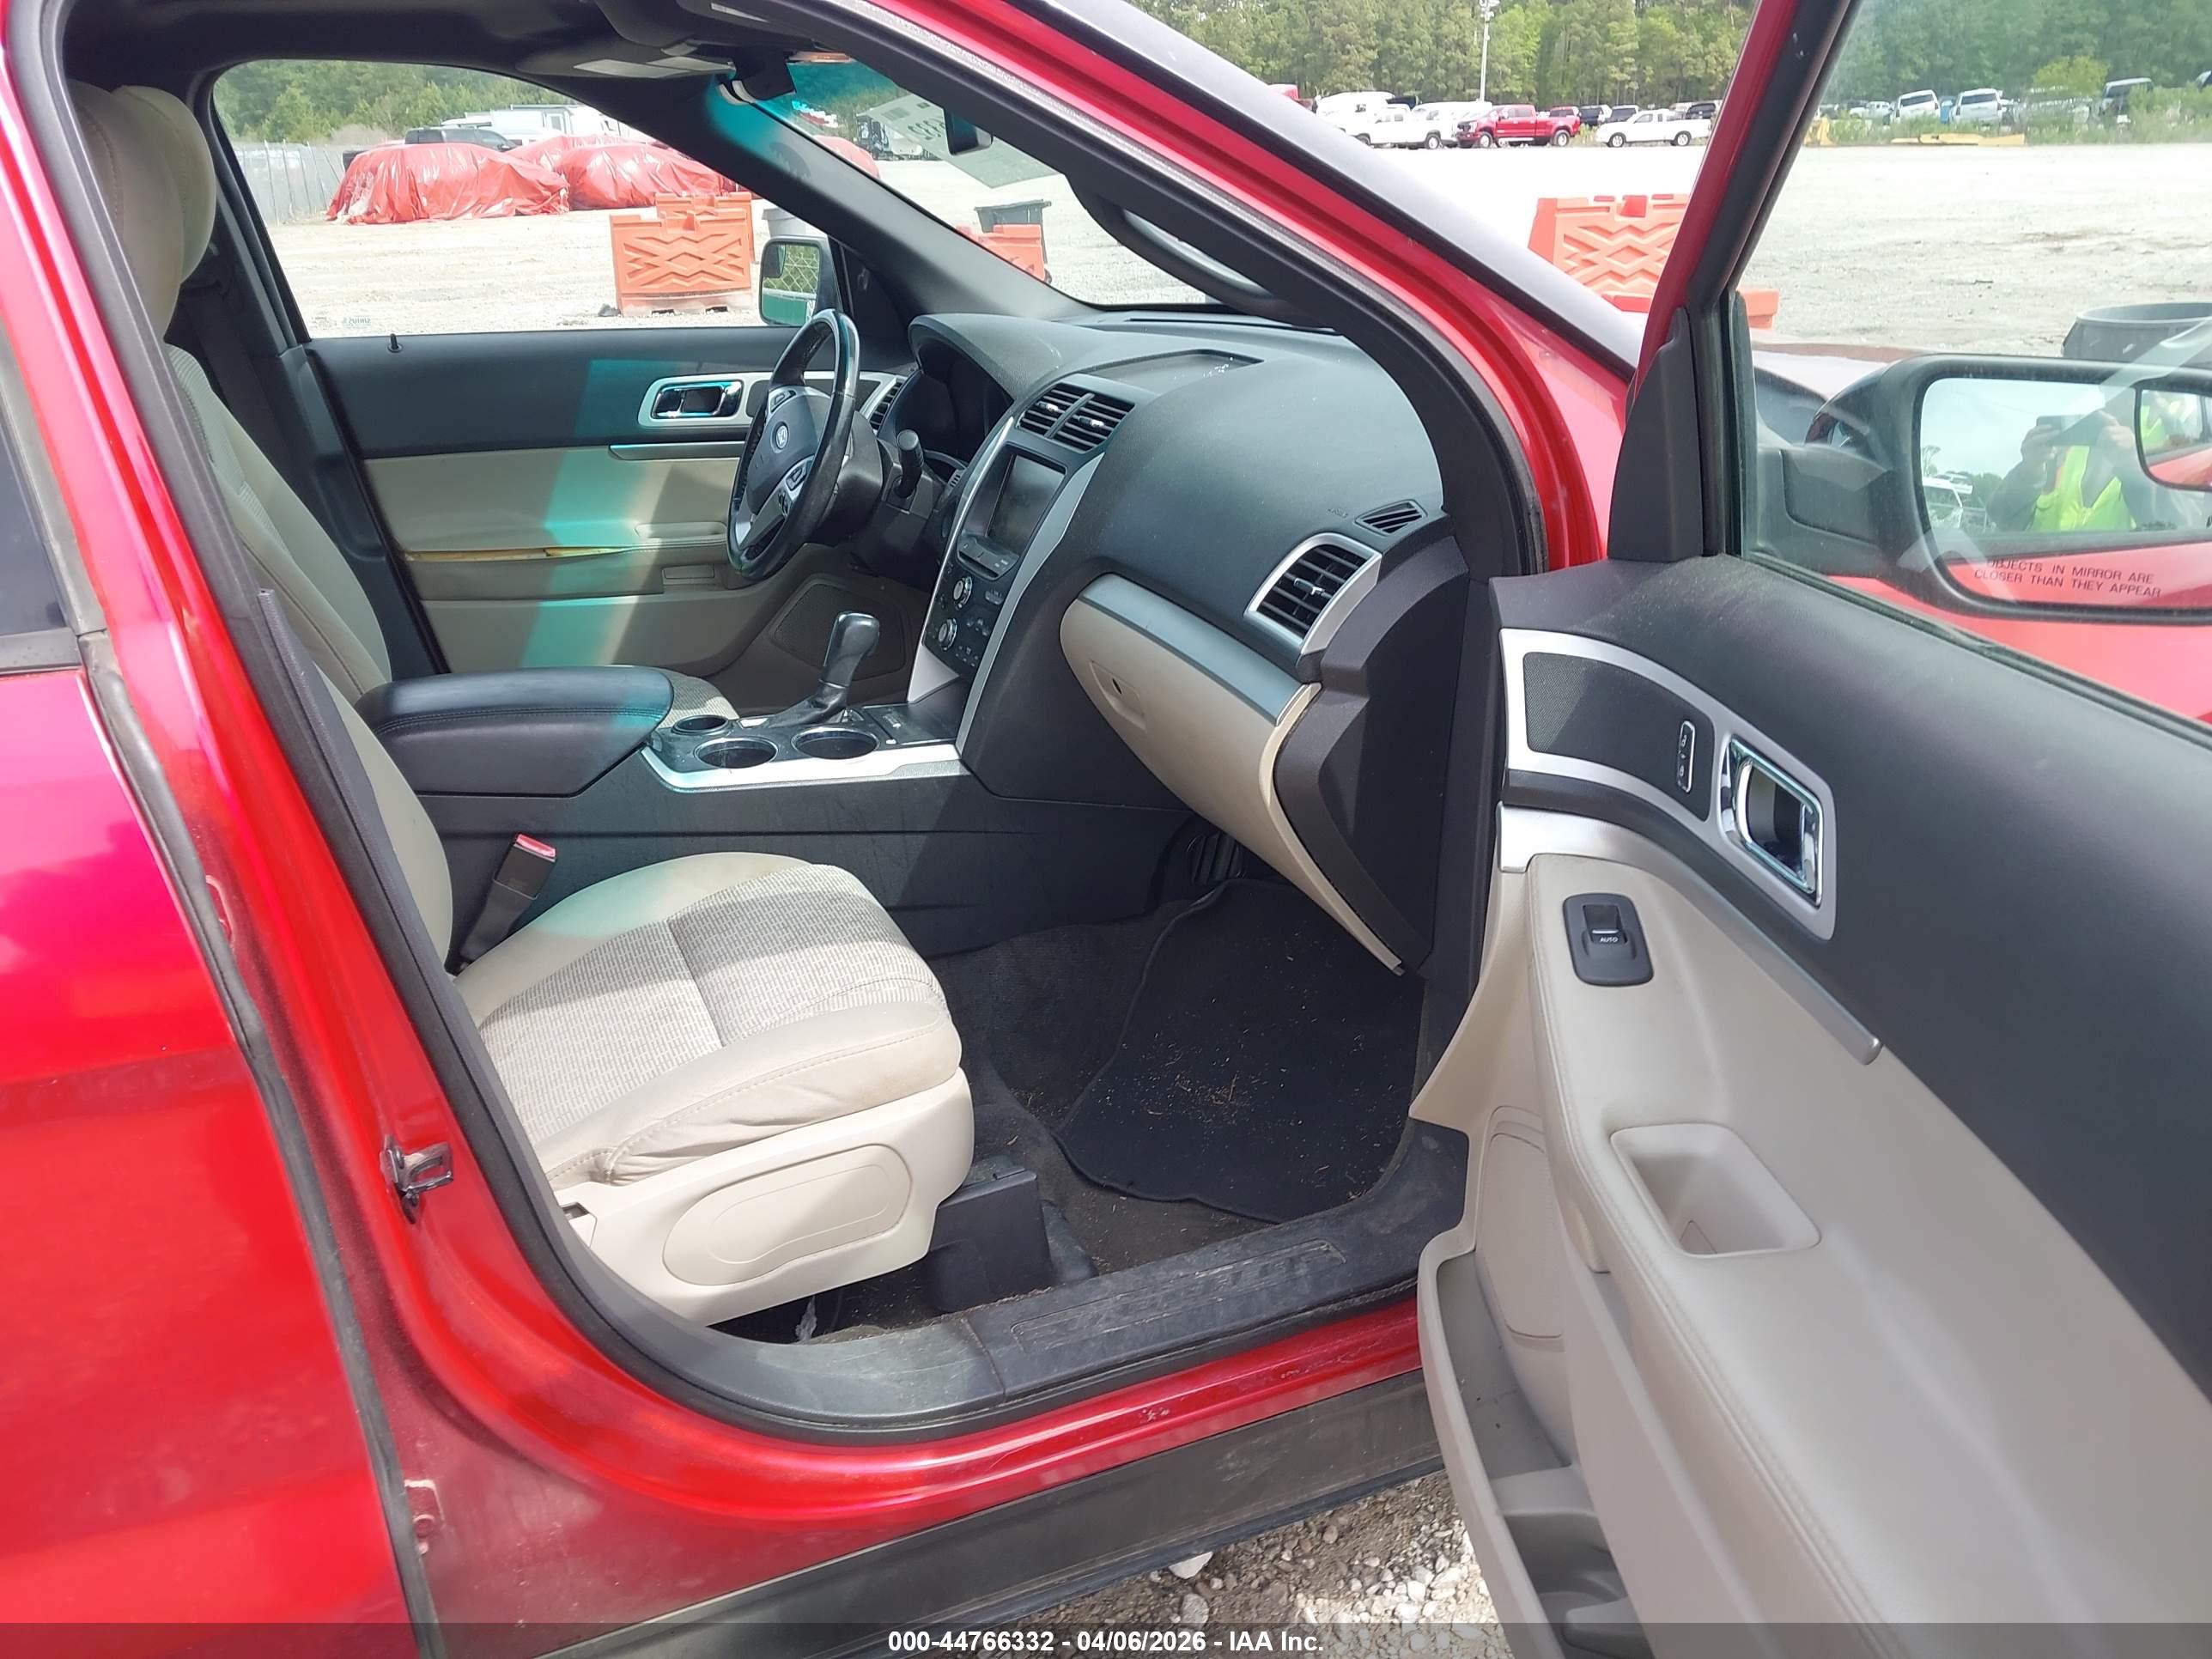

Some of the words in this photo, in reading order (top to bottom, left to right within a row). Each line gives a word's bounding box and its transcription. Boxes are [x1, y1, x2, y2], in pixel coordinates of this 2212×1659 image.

[1974, 568, 2023, 583] CLOSER
[2030, 574, 2063, 587] THAN
[2071, 579, 2104, 591] THEY
[2109, 584, 2162, 598] APPEAR
[1986, 559, 2043, 573] OBJECTS
[2052, 565, 2065, 574] IN
[2071, 566, 2122, 580] MIRROR
[2128, 572, 2154, 584] ARE
